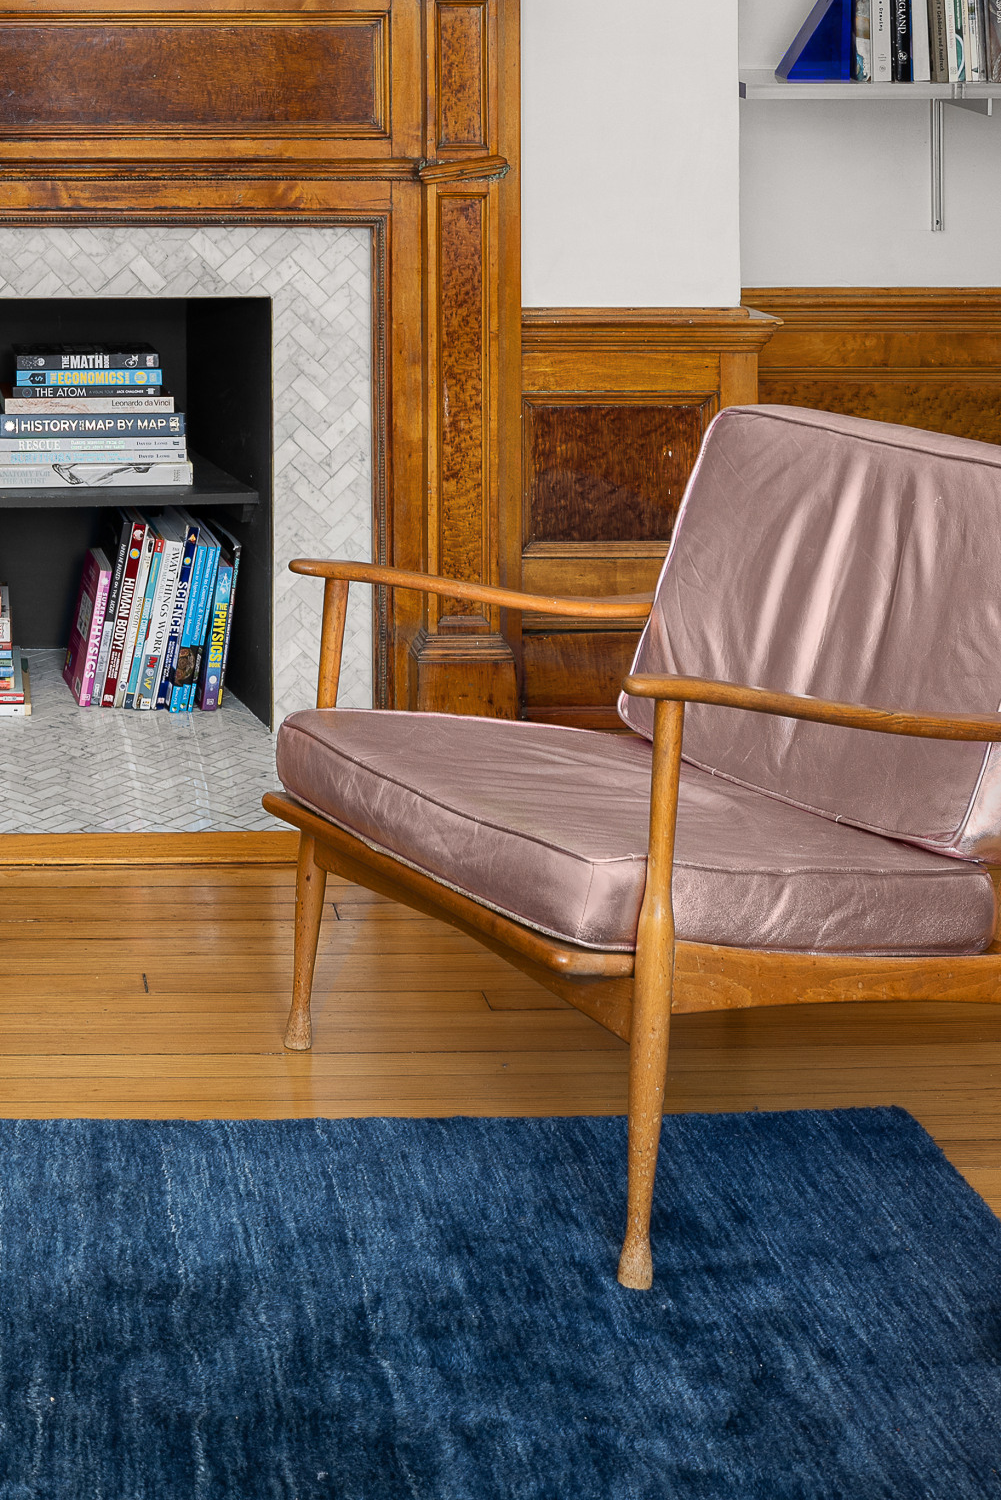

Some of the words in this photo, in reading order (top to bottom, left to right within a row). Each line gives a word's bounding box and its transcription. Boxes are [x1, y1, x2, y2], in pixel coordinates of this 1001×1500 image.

[35, 388, 55, 396] THE
[57, 388, 86, 396] ATOM
[58, 372, 124, 384] ECONOMICS
[21, 420, 79, 432] HISTORY
[85, 419, 114, 431] MAP
[117, 419, 134, 430] BY
[138, 419, 166, 430] MAP
[18, 440, 60, 450] RESCUE
[170, 552, 181, 575] WAY
[118, 578, 135, 618] HUMAN
[159, 577, 178, 618] THINGS
[169, 581, 188, 637] SCIENCE!
[85, 616, 103, 679] PHYSICS
[112, 619, 130, 650] BODY!
[153, 620, 167, 654] WORK
